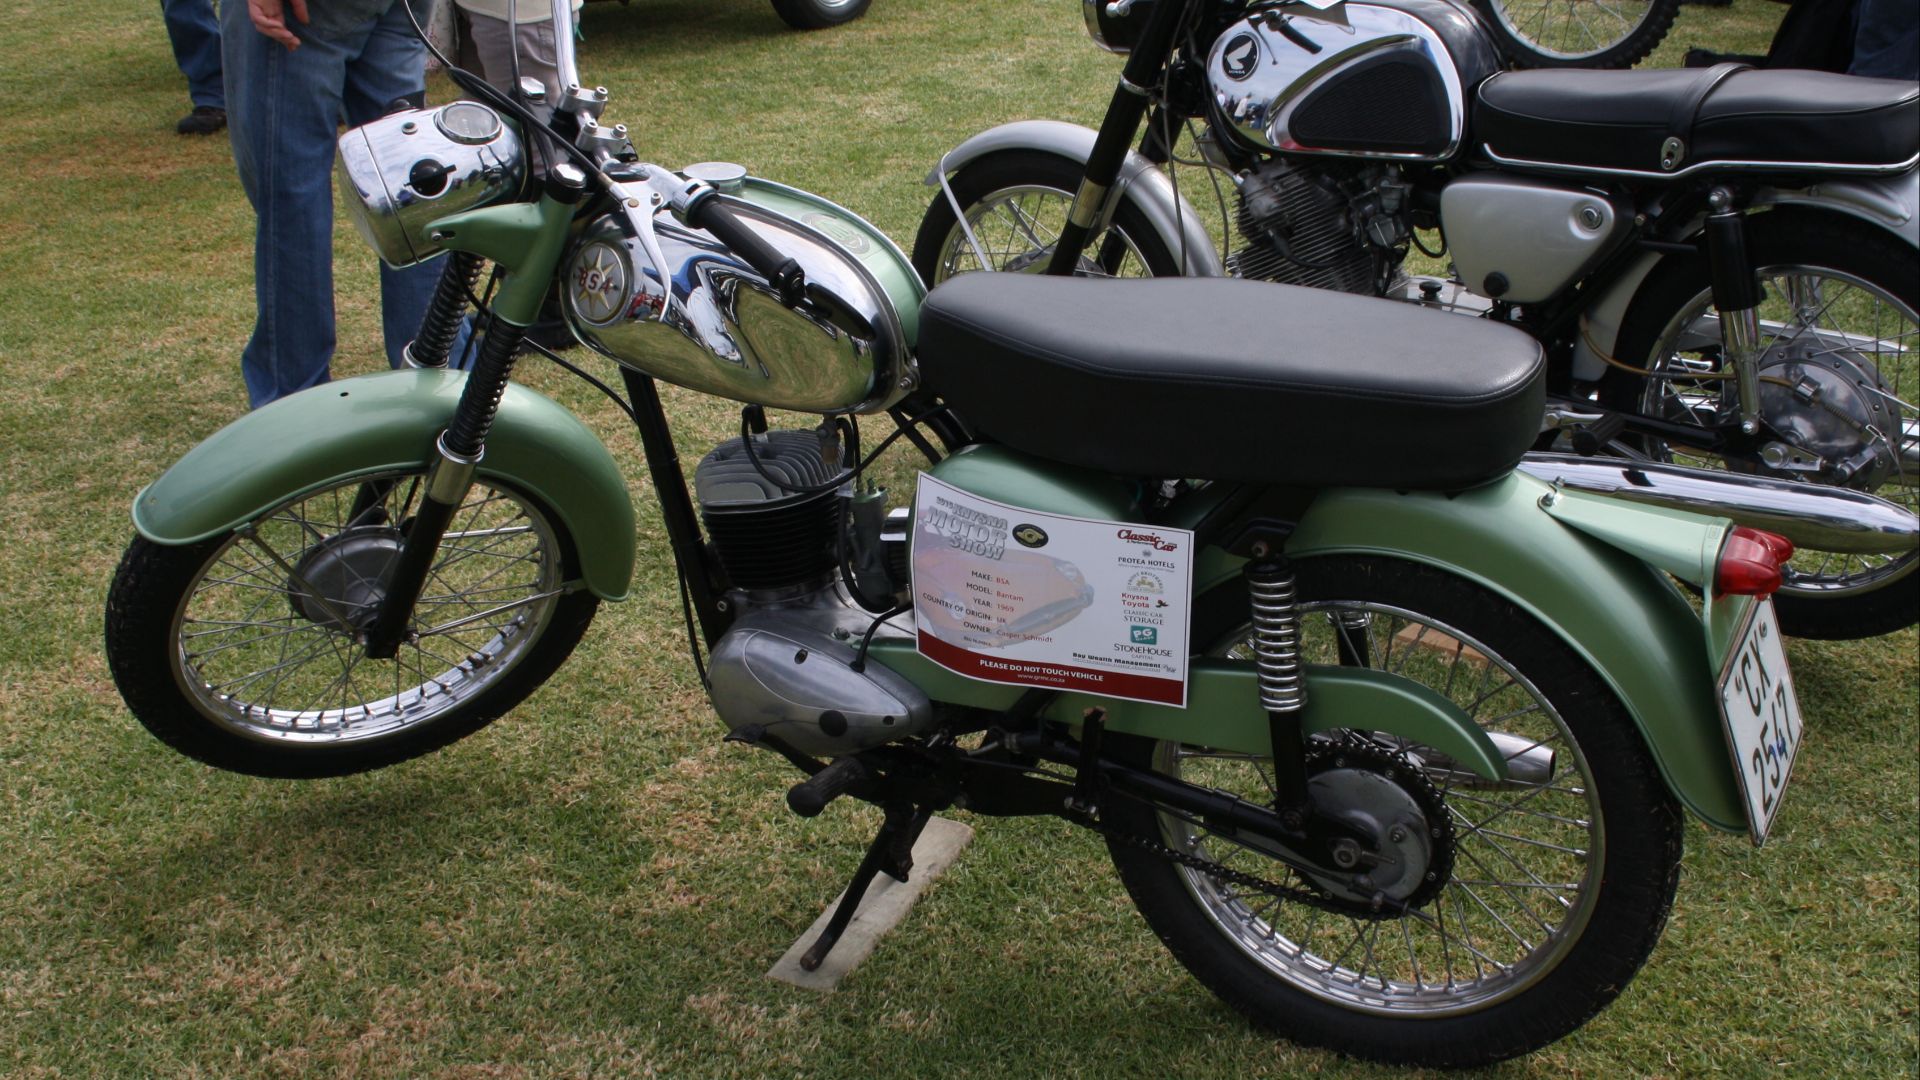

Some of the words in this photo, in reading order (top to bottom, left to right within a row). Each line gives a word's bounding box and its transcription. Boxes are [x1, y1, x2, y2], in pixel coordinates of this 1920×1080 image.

[578, 267, 613, 294] BSA
[924, 506, 1008, 547] MOTOR
[952, 503, 1008, 530] KNYSNA
[950, 534, 1005, 561] SHOW
[1118, 529, 1160, 543] Classic
[1154, 540, 1177, 552] Car
[1118, 556, 1146, 565] PROTEA
[1148, 560, 1174, 569] HOTELS
[972, 570, 992, 582] MAKE:
[996, 577, 1010, 586] BSA
[966, 582, 992, 595] MODEL:
[996, 590, 1024, 602] Bantam
[1122, 592, 1149, 602] Knysna
[922, 592, 952, 609] COUNTRY
[954, 604, 964, 613] OF
[966, 608, 992, 621] ORIGIN:
[996, 616, 1006, 624] UK
[973, 598, 992, 608] YEAR:
[998, 603, 1014, 613] 1969
[1122, 600, 1150, 608] Toyota
[1124, 615, 1164, 625] STORAGE
[964, 622, 992, 634] OWNER:
[996, 630, 1020, 640] Casper
[1022, 634, 1052, 643] Schmidt
[1133, 628, 1152, 639] PG
[980, 659, 1008, 670] PLEASE
[1041, 667, 1070, 677] TOUCH
[1070, 671, 1104, 682] VEHICLE
[1088, 655, 1112, 663] Wealth
[1114, 658, 1161, 668] Management
[1741, 630, 1771, 717] CX
[1752, 678, 1794, 816] 2547
